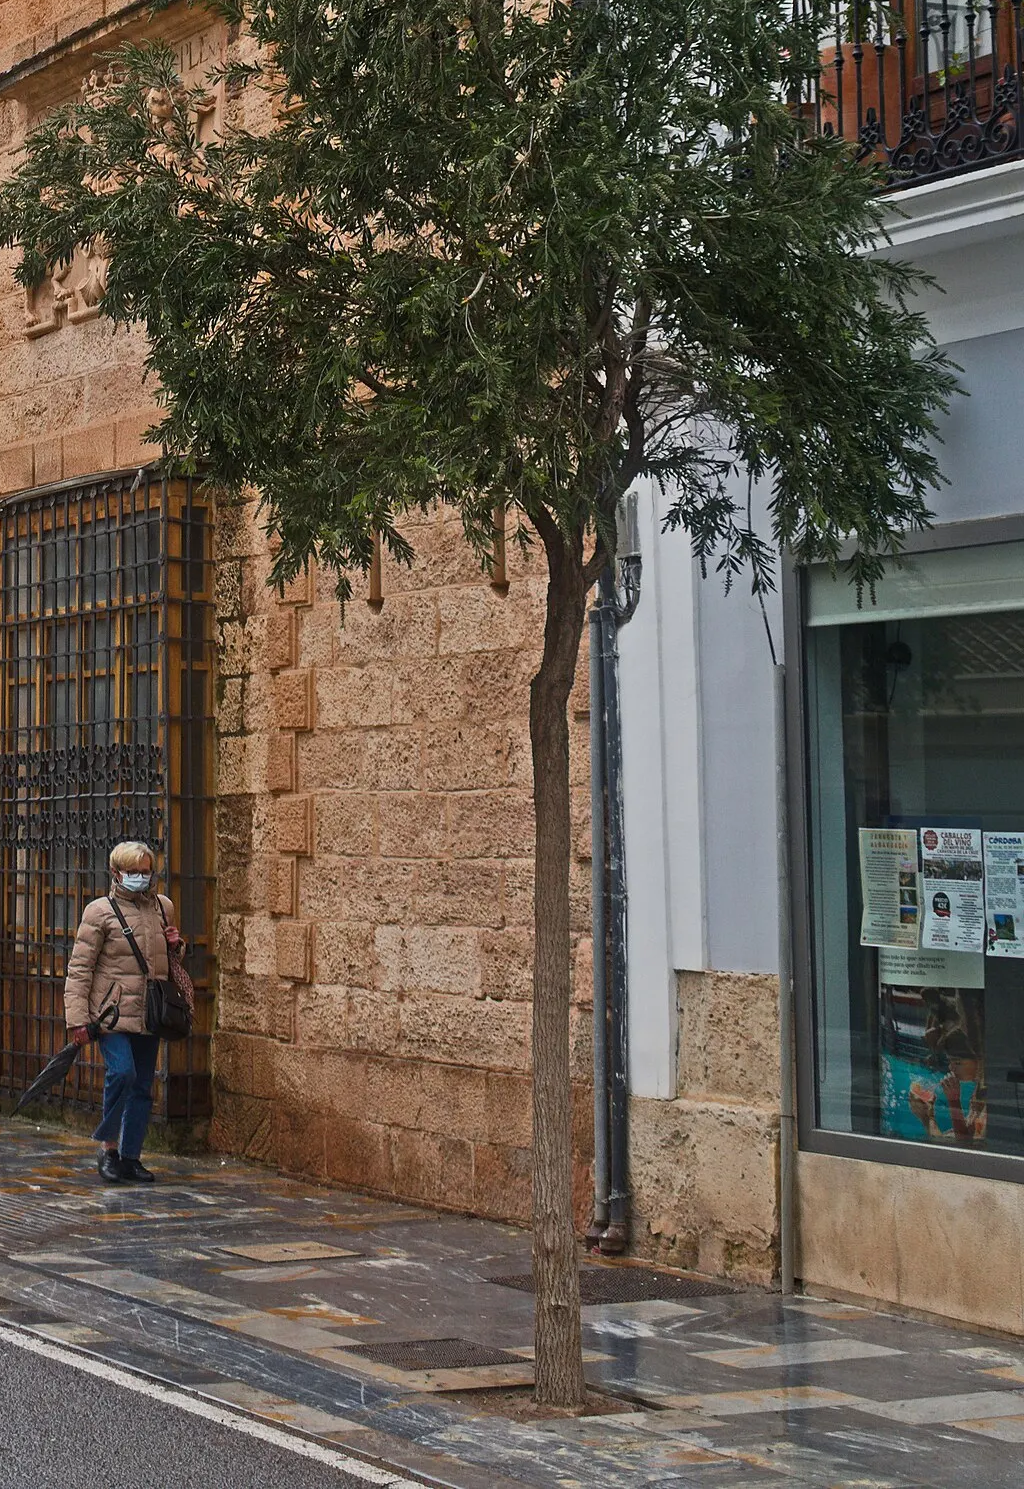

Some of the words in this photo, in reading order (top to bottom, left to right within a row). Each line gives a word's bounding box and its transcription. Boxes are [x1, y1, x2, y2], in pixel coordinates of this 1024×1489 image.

[940, 832, 972, 840] CABALLOS
[988, 836, 1022, 844] CÓRDOBA
[955, 839, 972, 847] VINO
